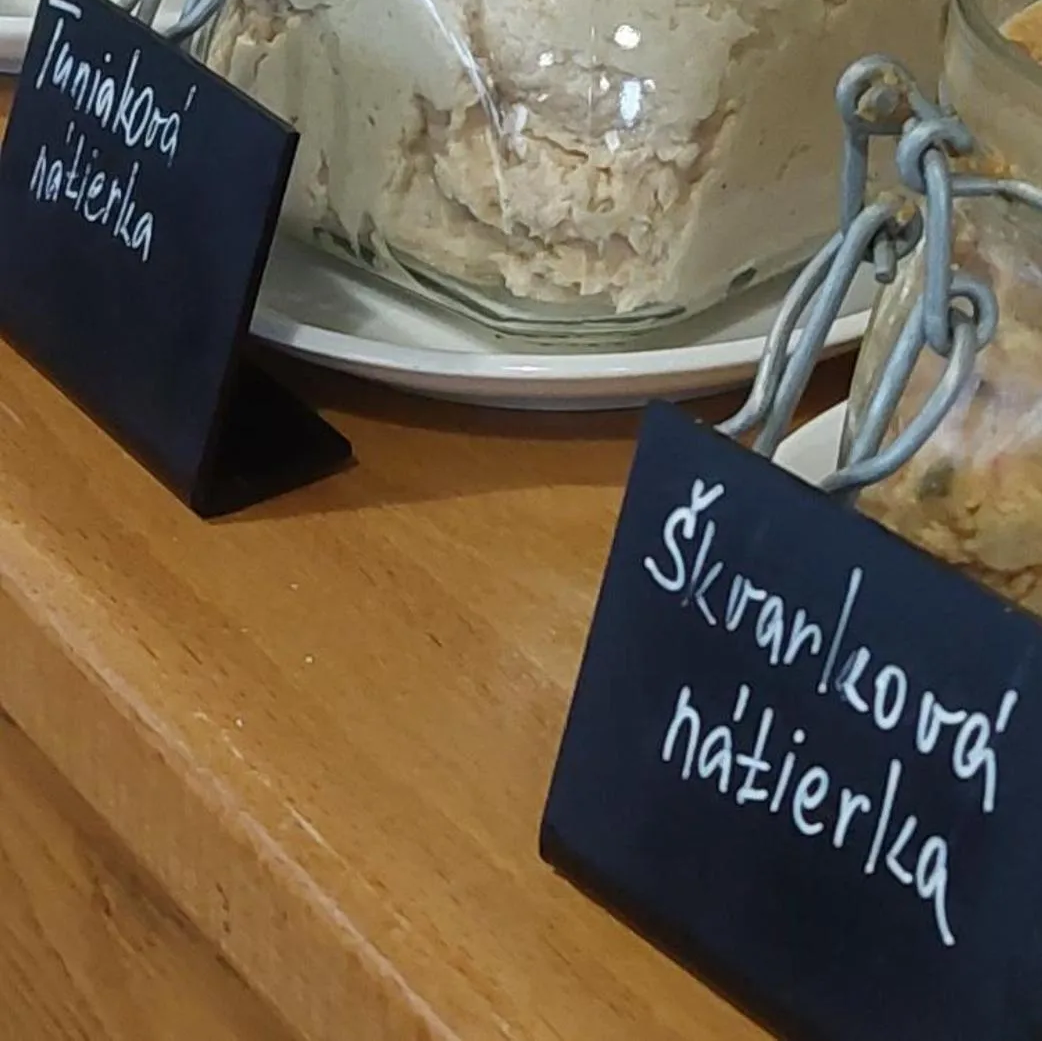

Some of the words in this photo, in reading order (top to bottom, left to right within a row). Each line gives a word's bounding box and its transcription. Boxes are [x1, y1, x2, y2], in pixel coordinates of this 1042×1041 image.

[29, 121, 154, 263] nátierka
[644, 478, 1018, 813] Škvarková
[662, 684, 955, 946] nátierka
